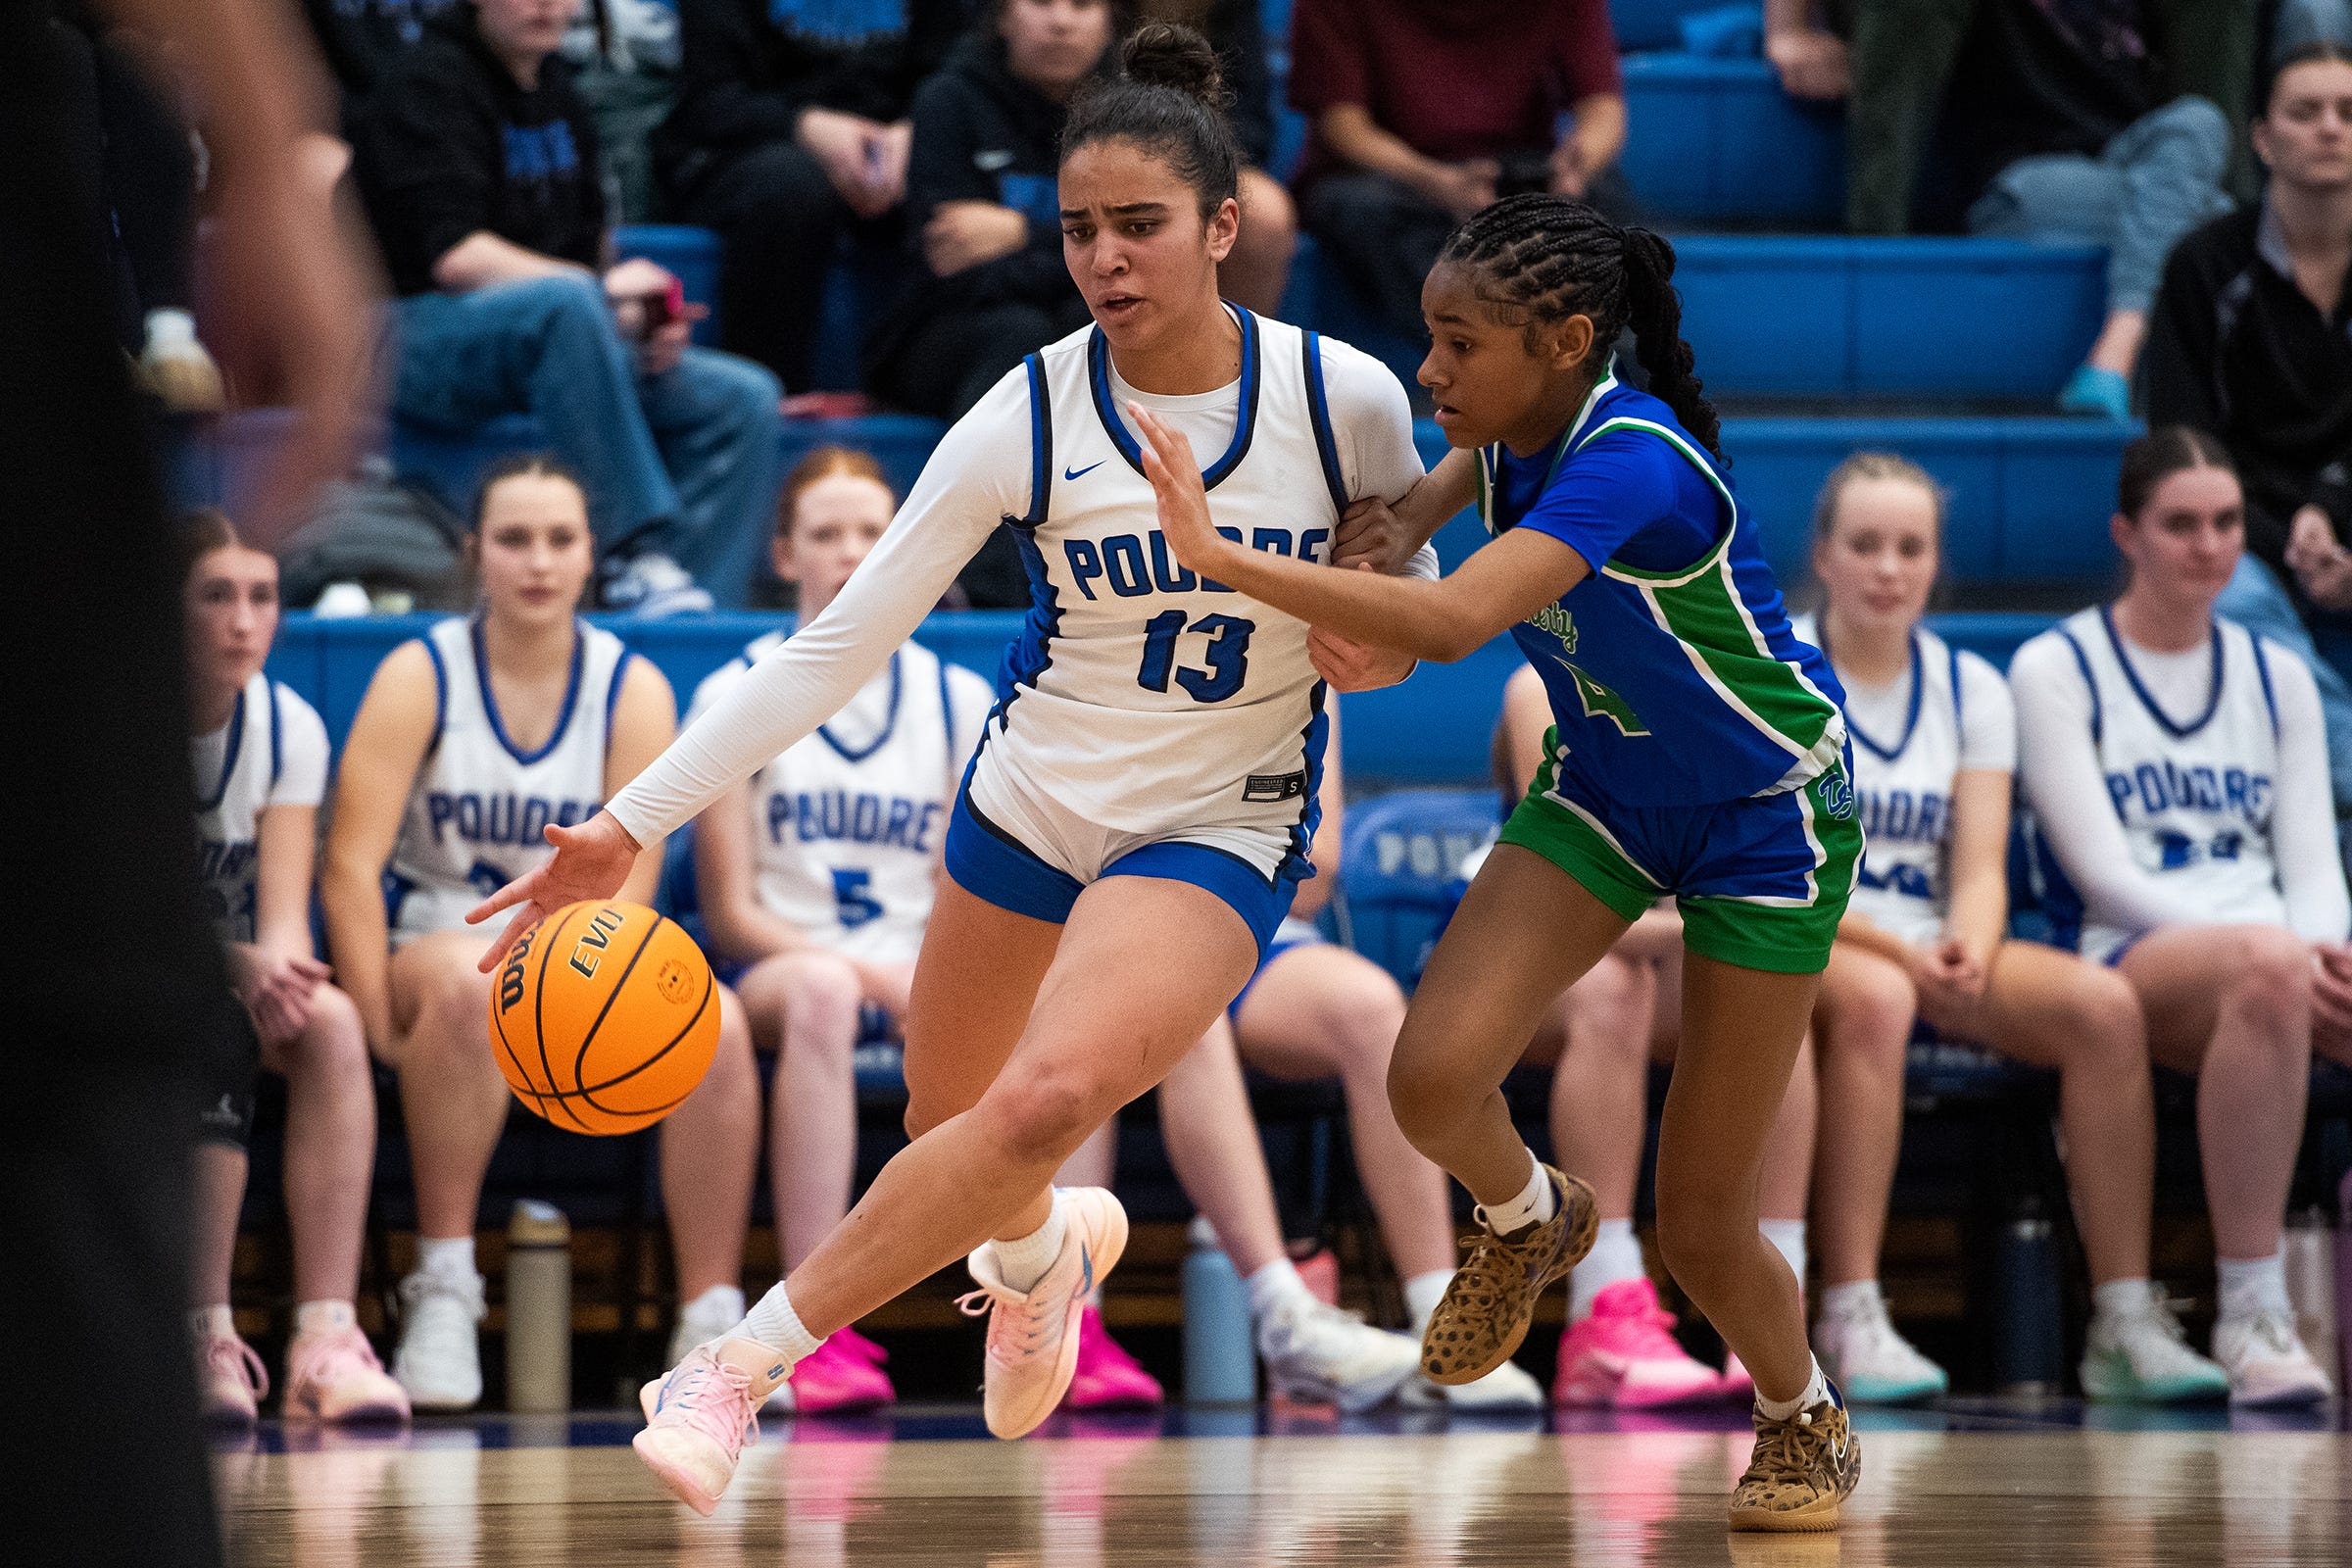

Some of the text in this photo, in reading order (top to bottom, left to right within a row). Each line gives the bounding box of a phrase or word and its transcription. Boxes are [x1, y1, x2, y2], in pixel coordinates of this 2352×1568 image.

[1137, 610, 1256, 704] 13
[1289, 781, 1298, 793] S
[768, 790, 944, 855] POUDRE
[830, 866, 885, 929] 5
[568, 907, 625, 979] EVO
